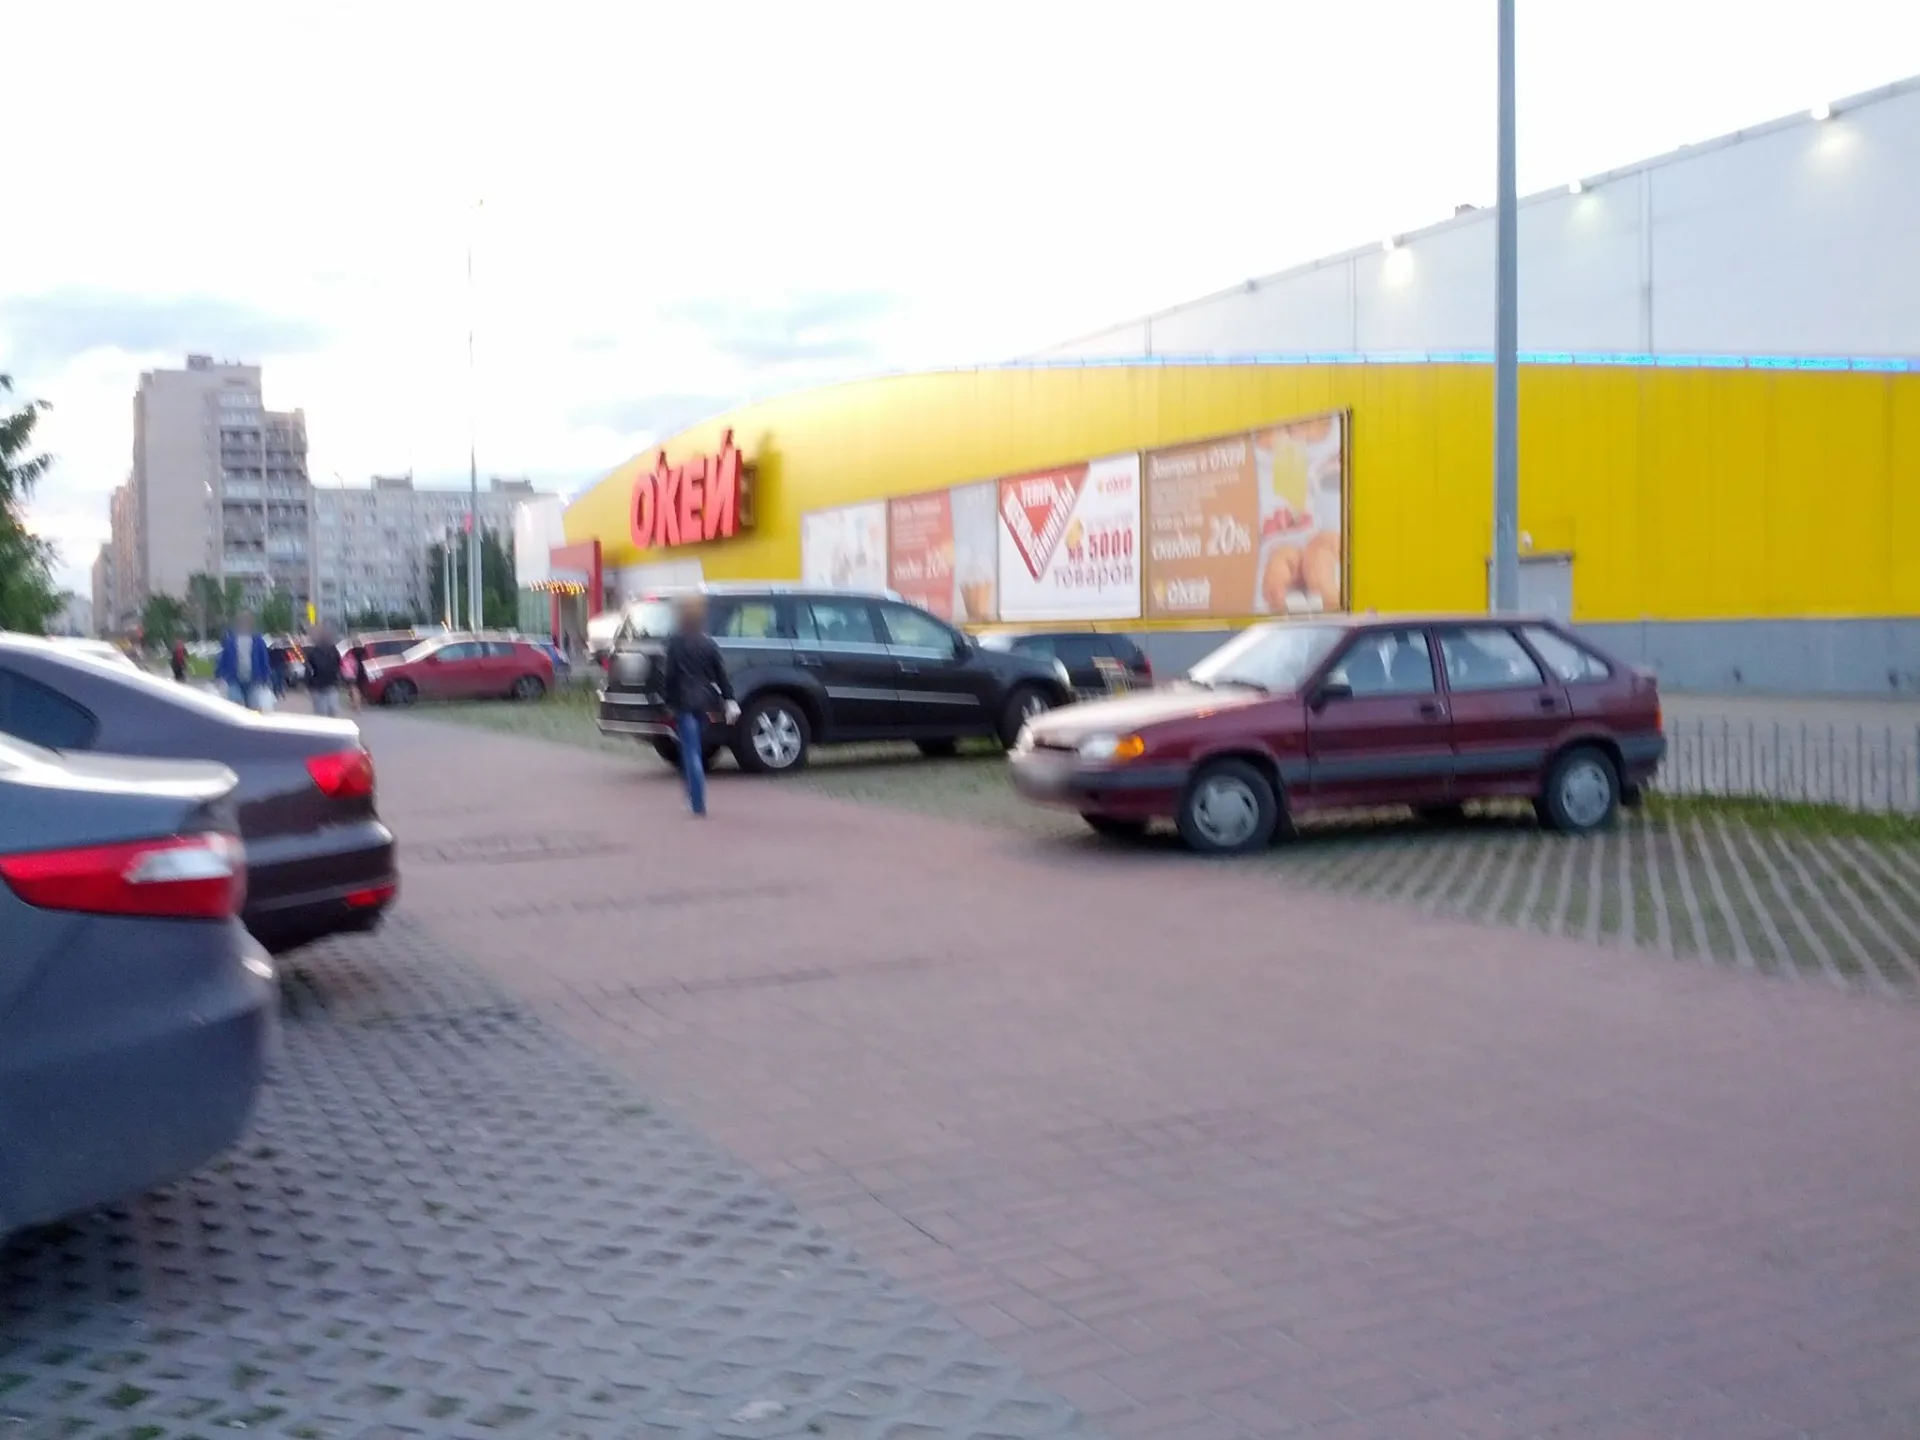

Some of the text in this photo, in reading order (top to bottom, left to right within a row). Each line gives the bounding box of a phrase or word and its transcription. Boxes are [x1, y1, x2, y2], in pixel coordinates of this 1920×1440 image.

[1088, 528, 1133, 561] 5000
[1206, 513, 1251, 557] 20%
[1052, 561, 1134, 595] товаров
